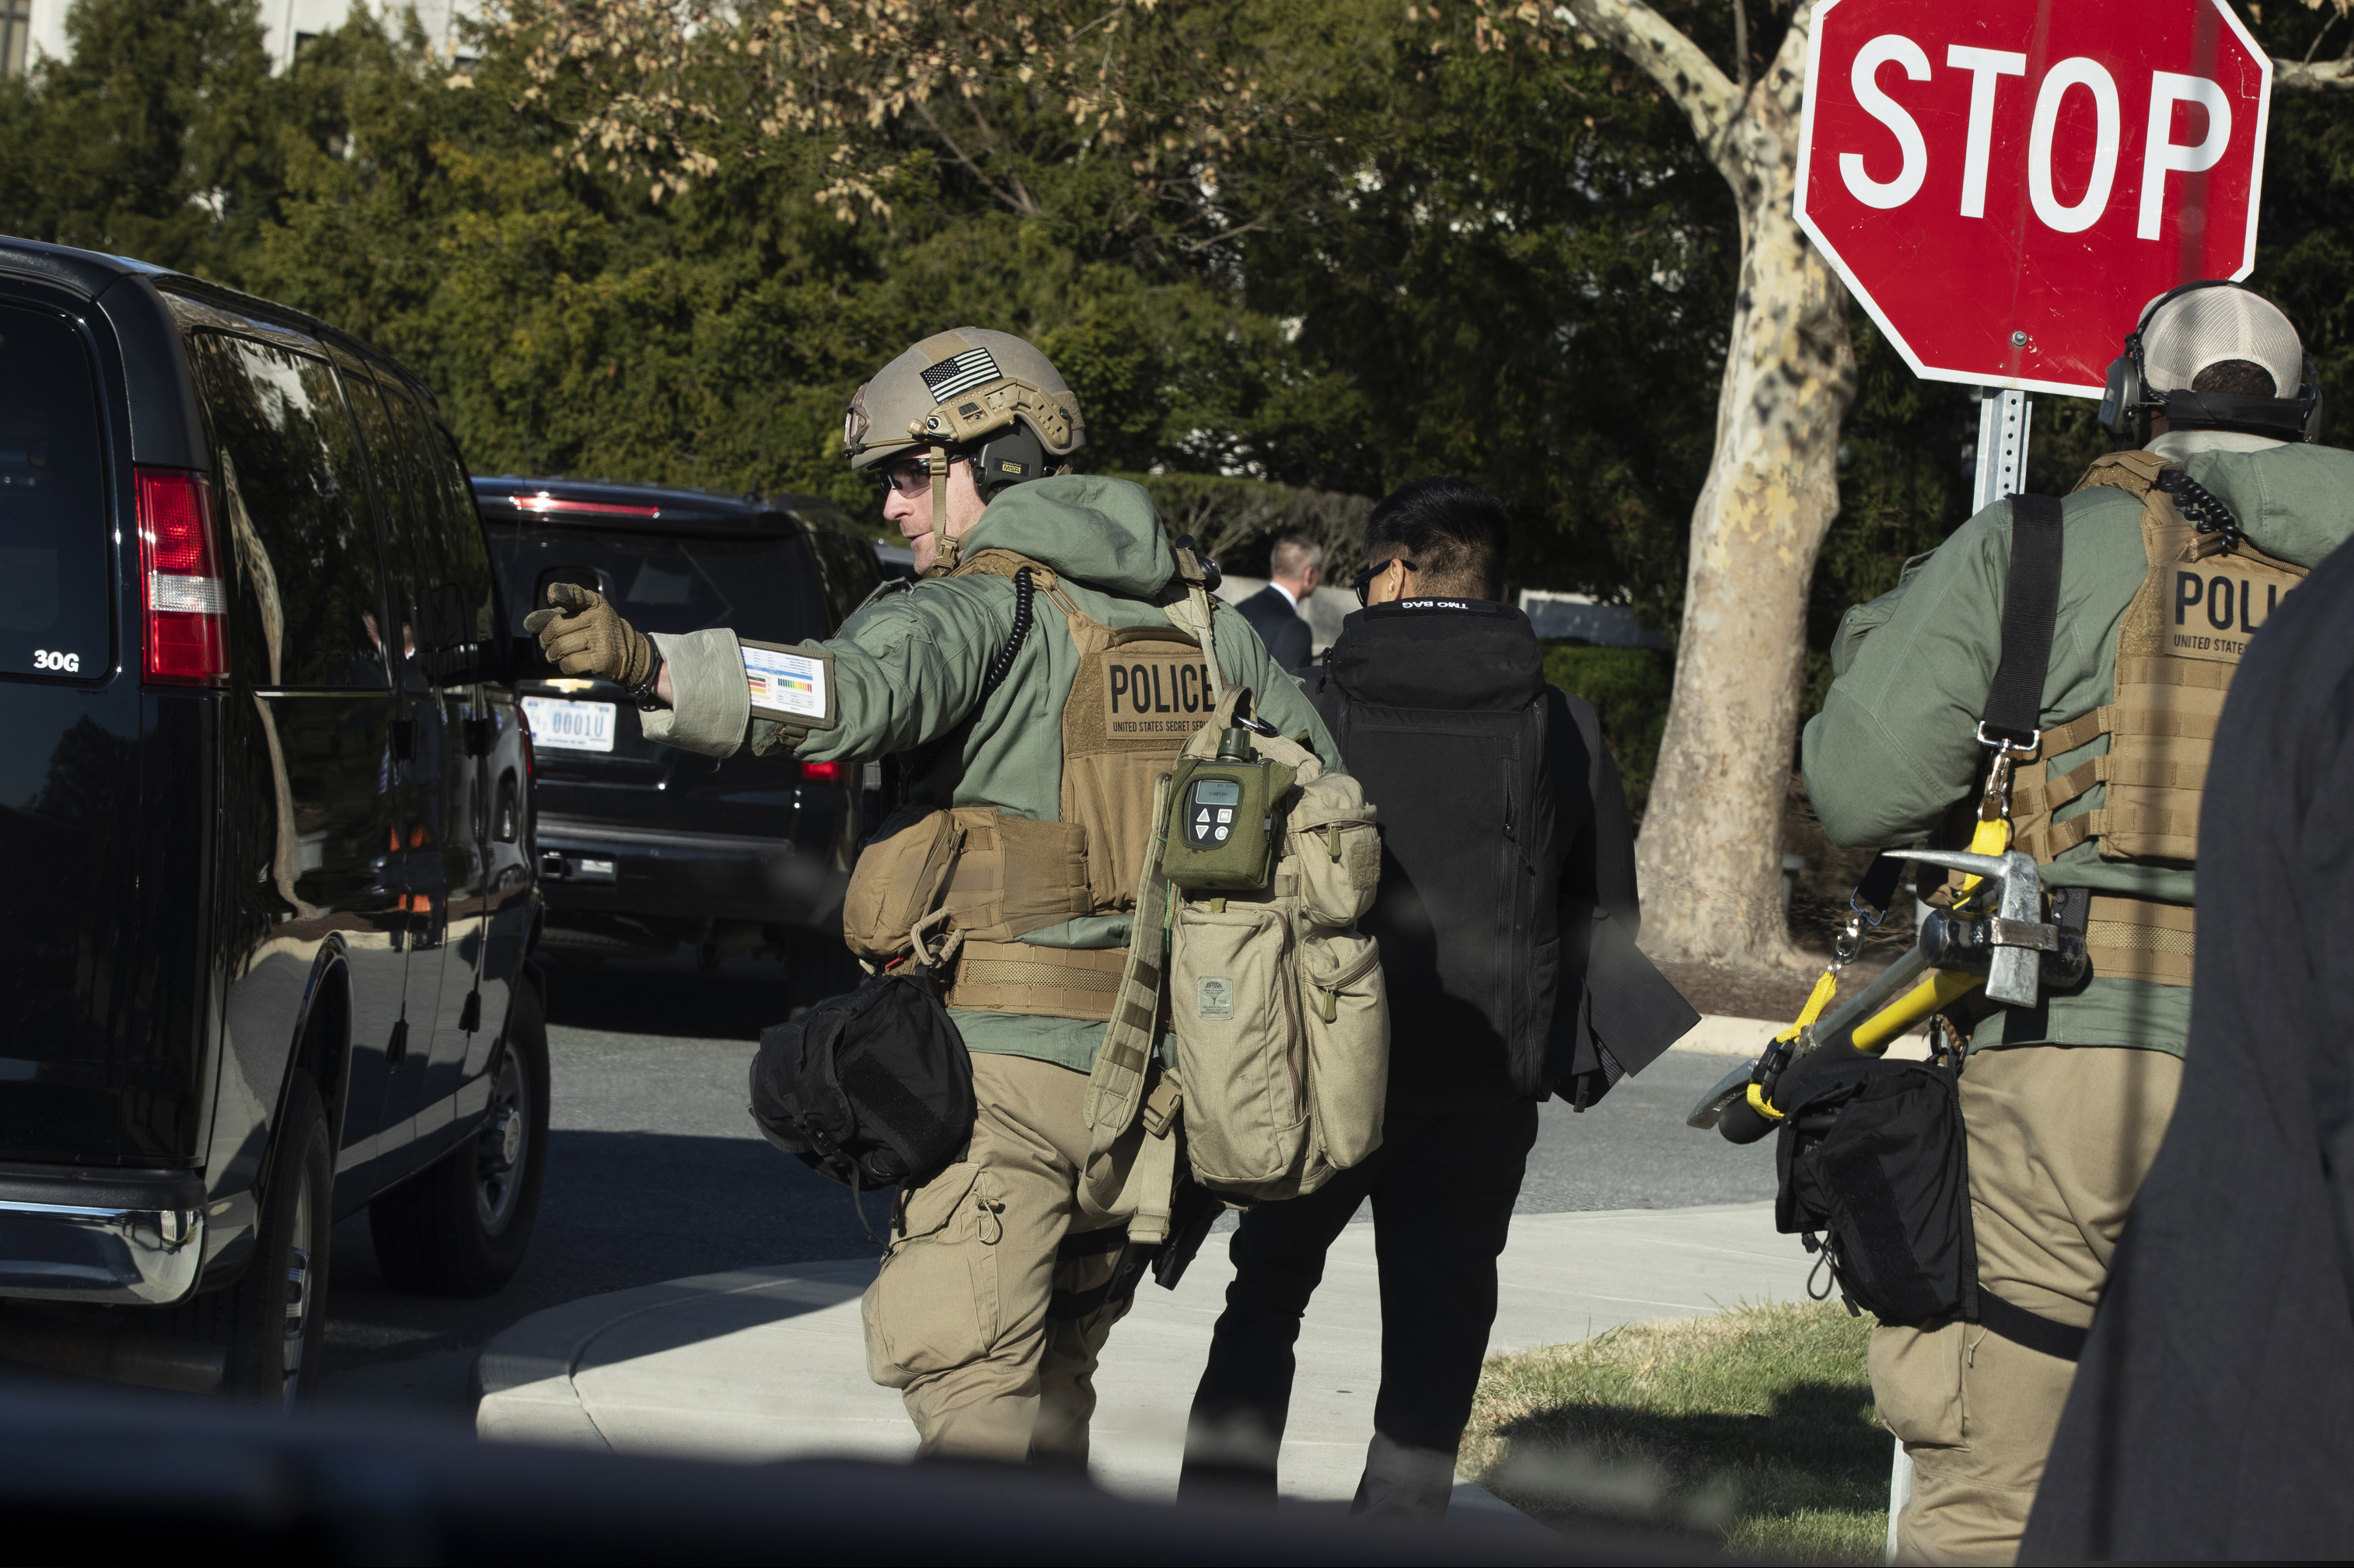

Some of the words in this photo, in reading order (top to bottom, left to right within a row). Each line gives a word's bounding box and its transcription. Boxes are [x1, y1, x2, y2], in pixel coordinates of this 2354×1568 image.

[1839, 33, 2232, 241] STOP
[1004, 465, 1020, 473] MSA
[2175, 571, 2294, 634] POLI
[2174, 634, 2210, 650] UNITED
[33, 649, 79, 672] 30G
[1109, 664, 1216, 714] POLICE
[1113, 721, 1137, 732] UNITED
[1140, 721, 1163, 732] STATES
[1166, 721, 1189, 732] SECRET
